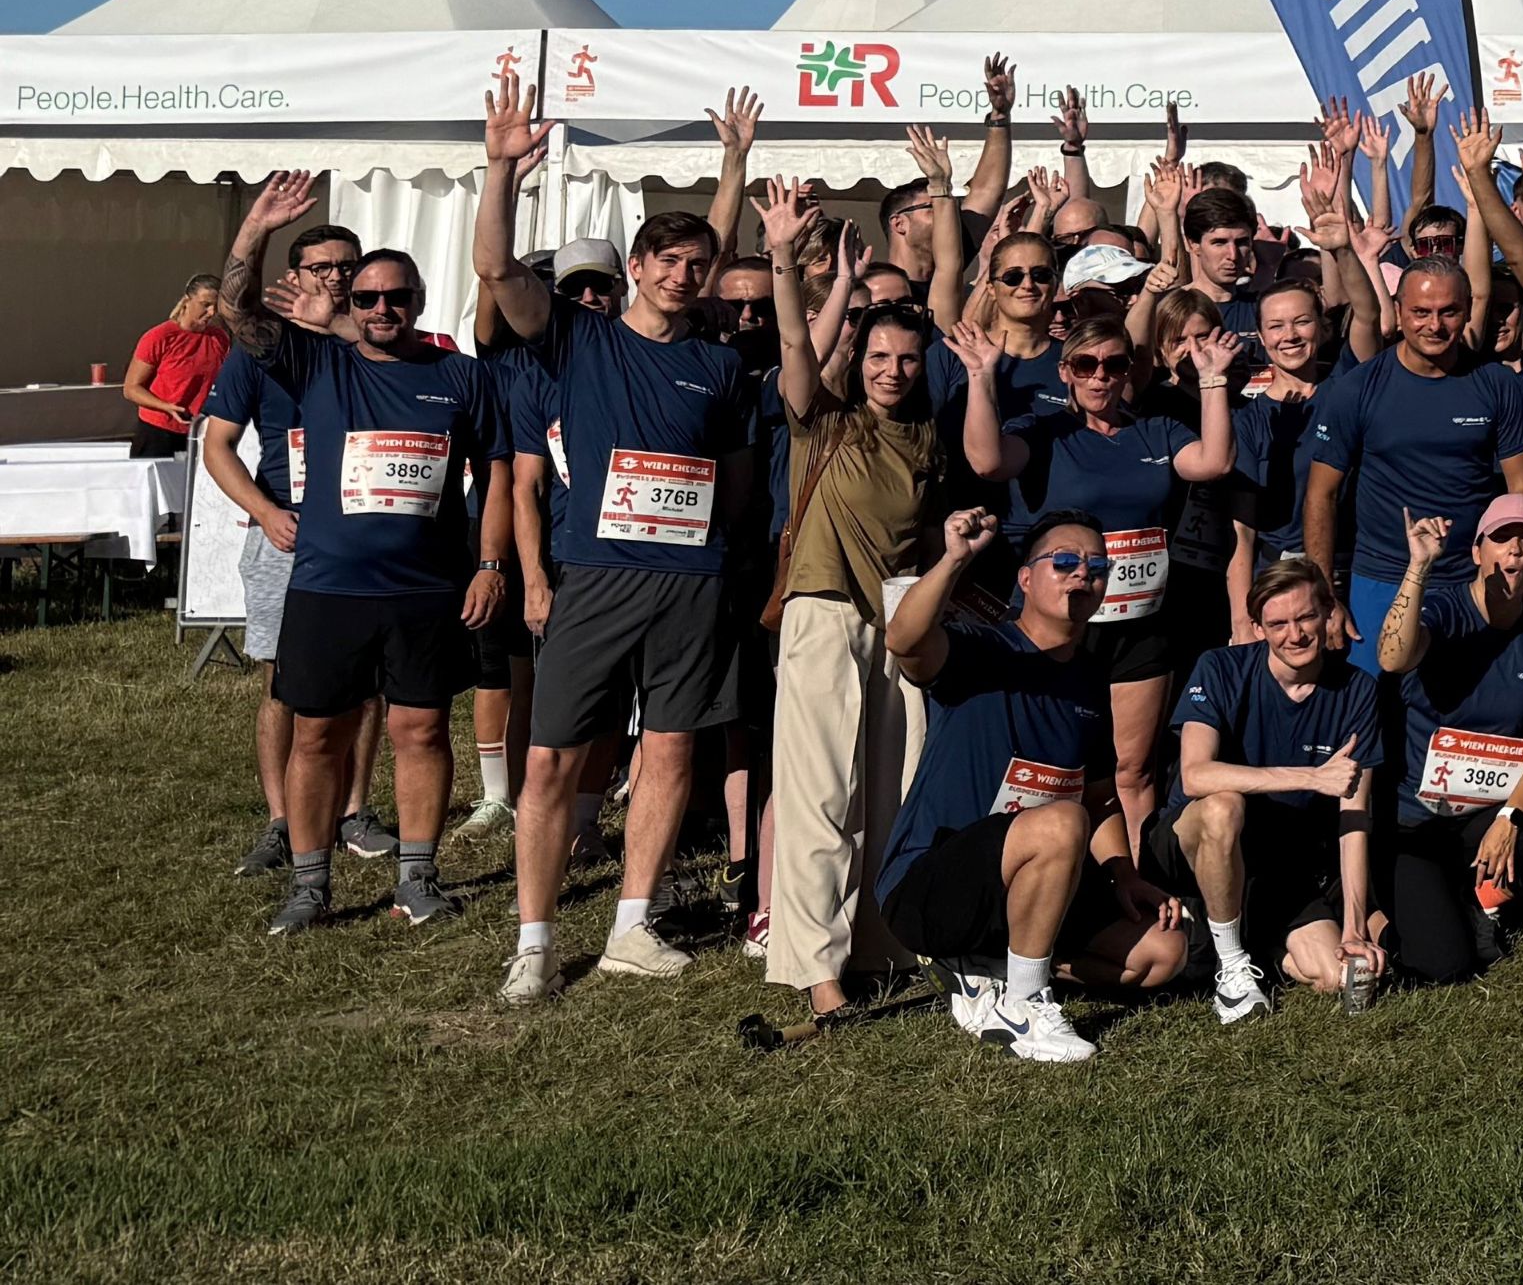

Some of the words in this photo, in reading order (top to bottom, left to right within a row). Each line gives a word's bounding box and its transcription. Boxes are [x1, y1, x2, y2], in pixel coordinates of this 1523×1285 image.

[16, 82, 291, 116] People.Health.Care.
[918, 82, 1199, 113] Peop.Helth.Care.
[375, 437, 403, 449] WIEN
[386, 461, 433, 480] 389C
[642, 456, 671, 471] WIEN
[650, 487, 699, 507] 376B
[1117, 561, 1157, 582] 361C
[1459, 738, 1485, 752] WIEN
[1036, 772, 1061, 786] WIEN
[1463, 768, 1509, 788] 398C
